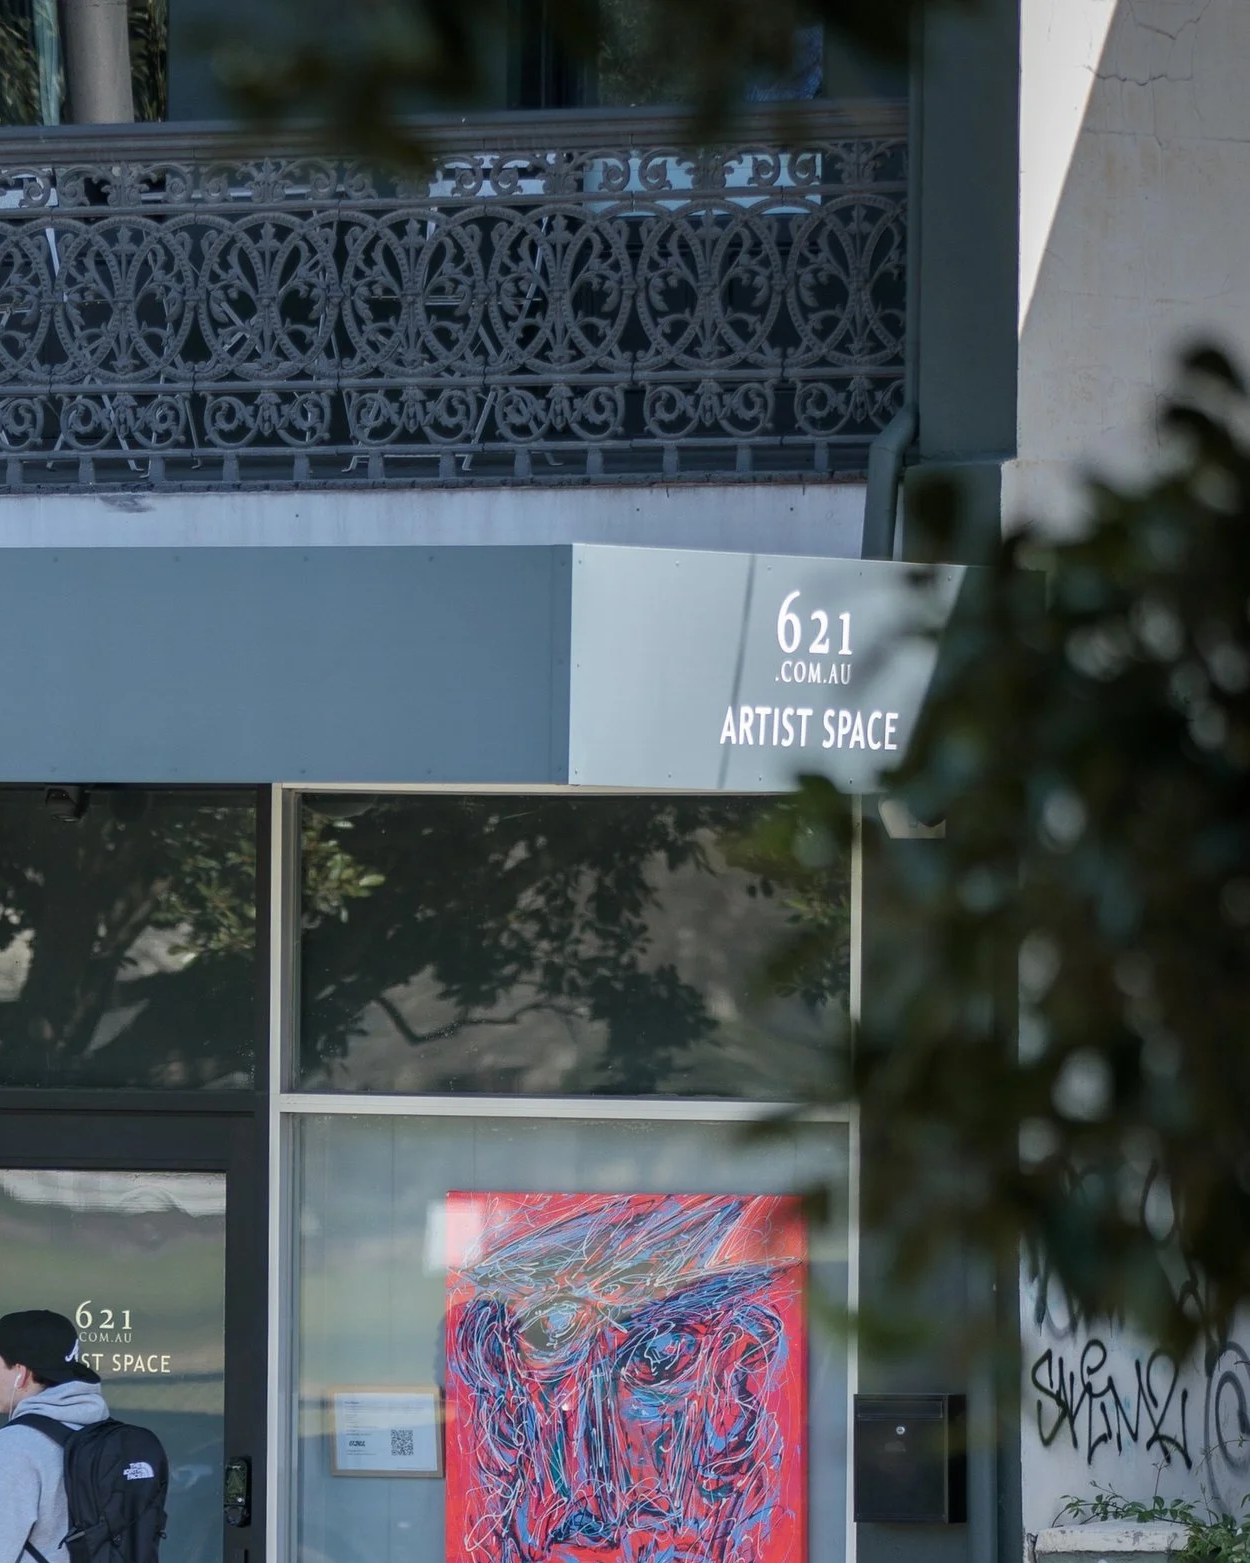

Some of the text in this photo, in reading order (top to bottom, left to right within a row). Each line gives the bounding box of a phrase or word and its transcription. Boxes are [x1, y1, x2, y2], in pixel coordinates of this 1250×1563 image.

[778, 590, 852, 655] 621
[775, 661, 851, 685] .COM.AU
[720, 706, 899, 750] ARTIST SPACE
[75, 1300, 132, 1330] 621
[112, 1354, 171, 1373] SPACE
